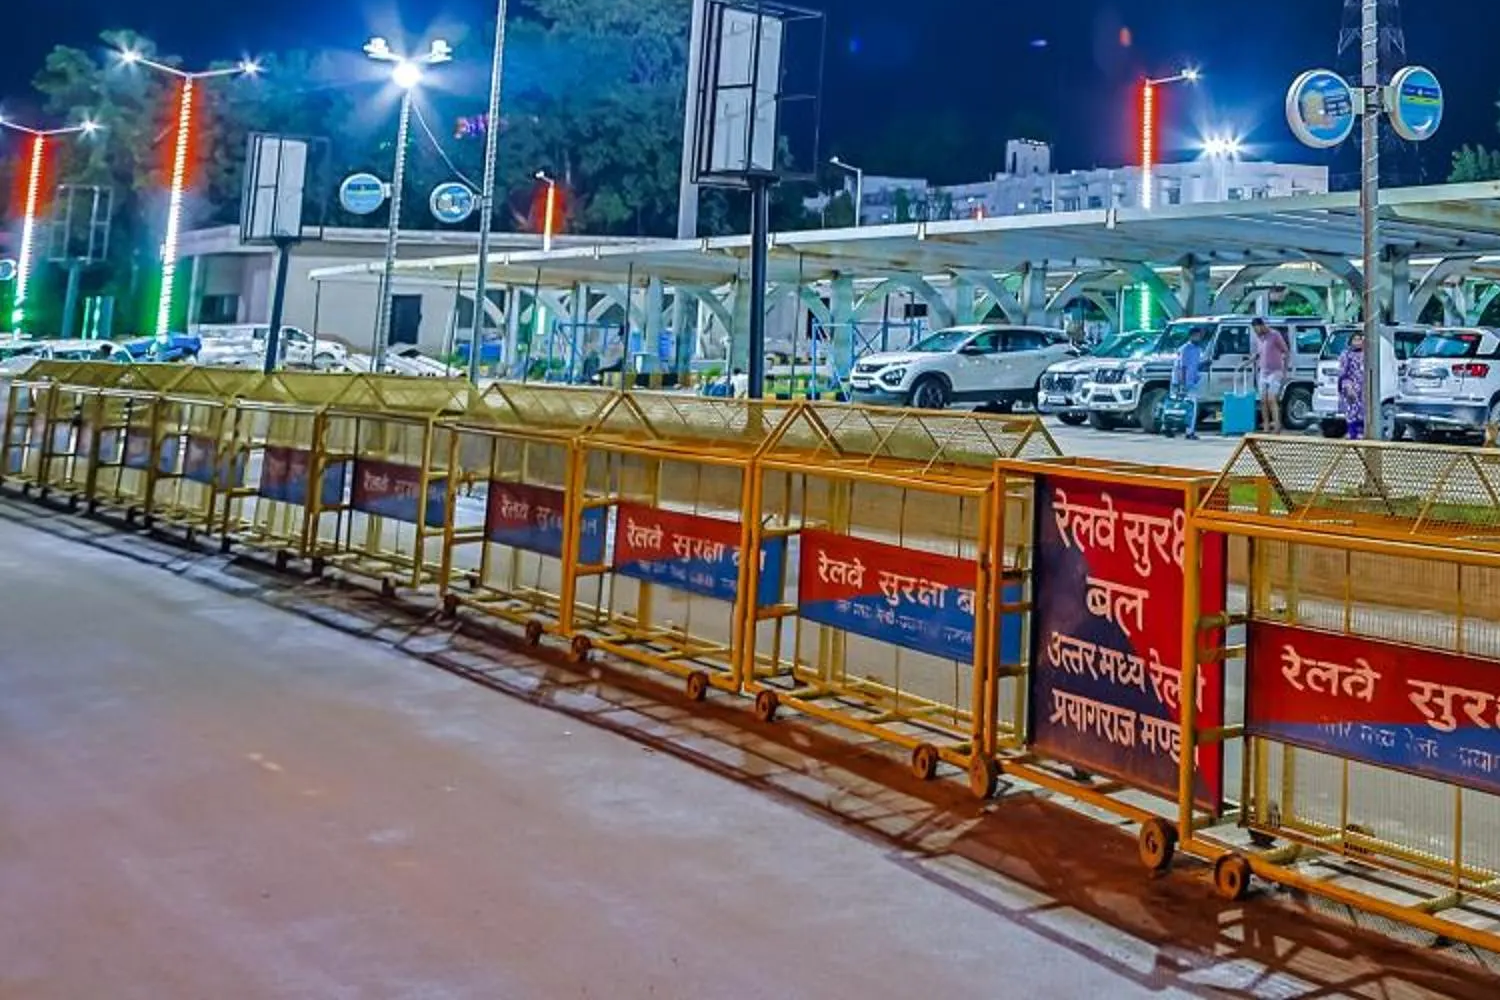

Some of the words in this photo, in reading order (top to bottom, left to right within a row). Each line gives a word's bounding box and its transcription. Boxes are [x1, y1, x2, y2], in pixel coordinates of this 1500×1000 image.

[626, 517, 664, 550] रेलवे
[672, 534, 724, 562] सुरक्षा
[1052, 488, 1119, 553] रेलवे
[1122, 508, 1203, 577] सुरक्ष
[818, 551, 866, 590] रेलवे
[879, 571, 949, 609] सुरक्षा
[957, 587, 991, 616] ब
[1086, 574, 1150, 637] बल
[1047, 631, 1099, 681] उत्तर
[1098, 645, 1147, 693] मध्य
[1281, 644, 1382, 702] रेलवे
[1049, 687, 1137, 748] प्रयागराज
